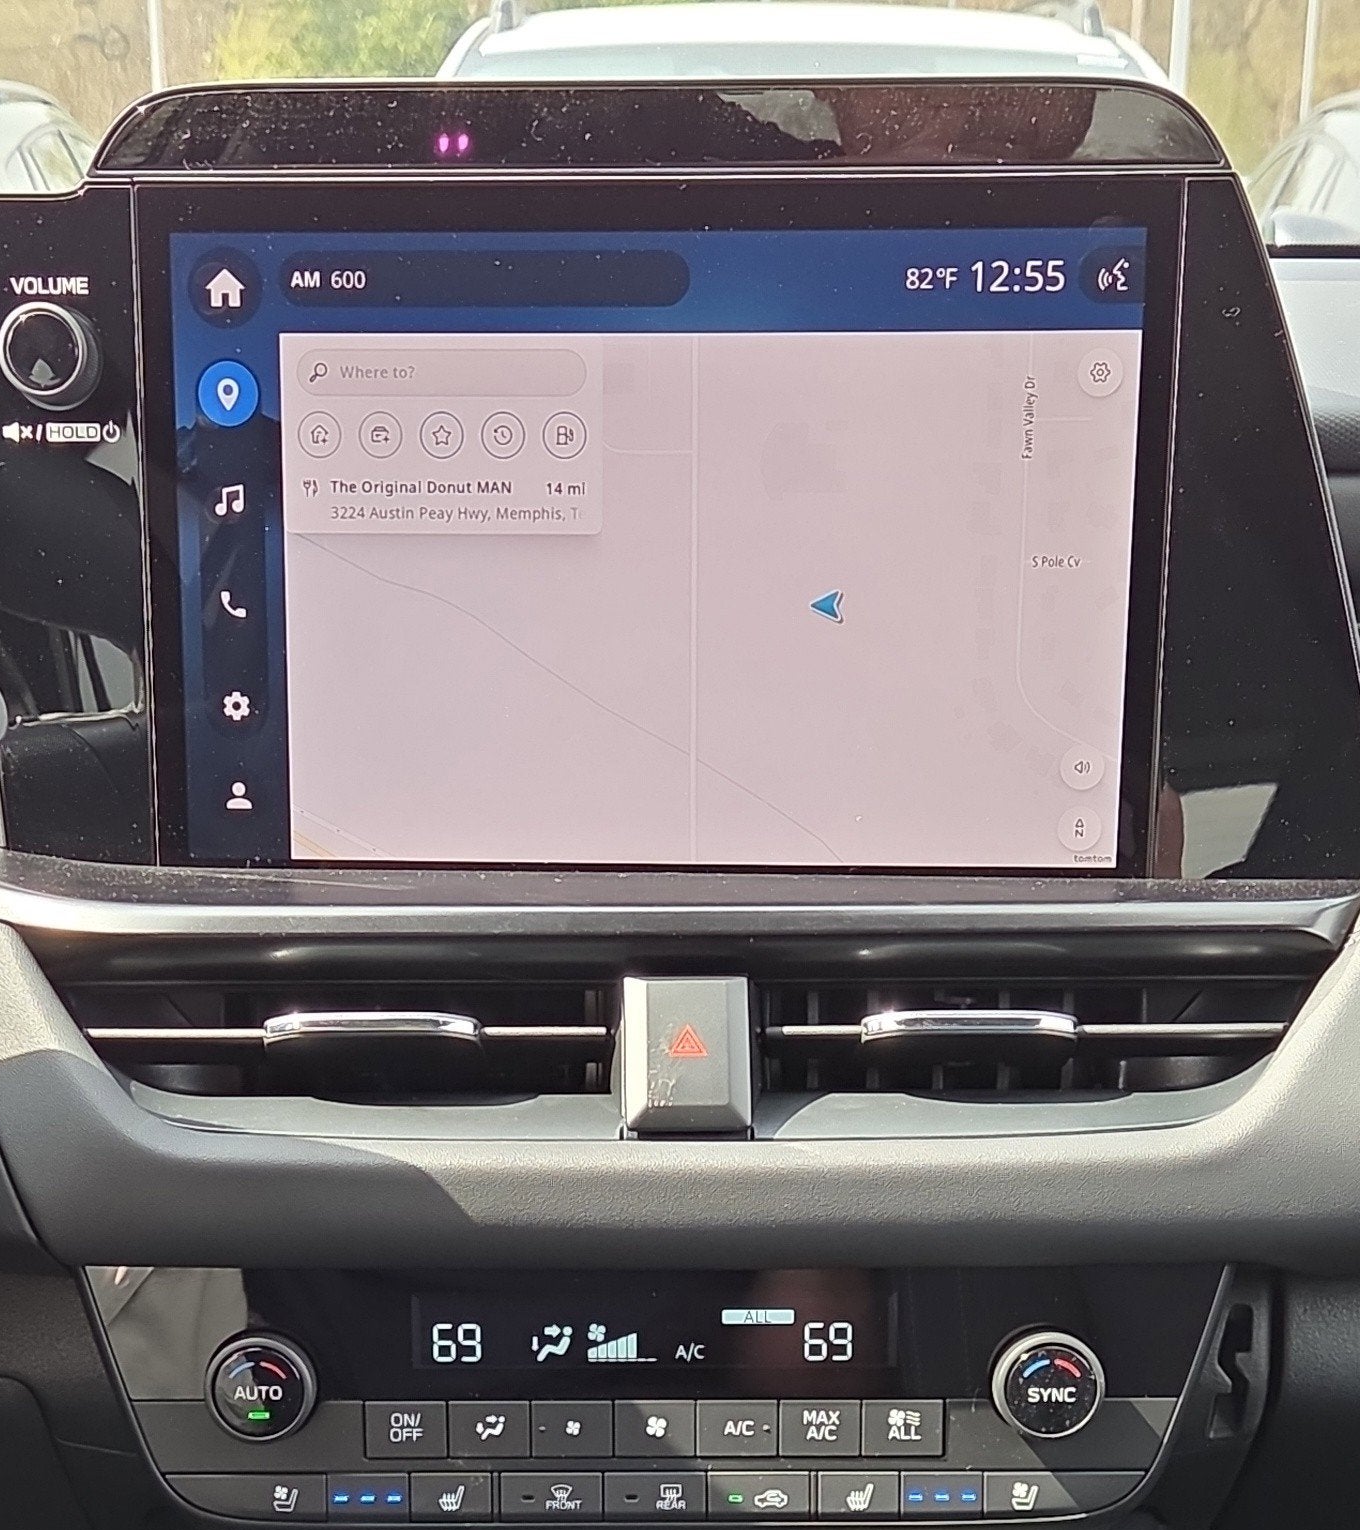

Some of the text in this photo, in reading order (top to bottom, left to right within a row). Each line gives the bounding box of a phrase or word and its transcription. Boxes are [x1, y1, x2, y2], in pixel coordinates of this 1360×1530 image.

[290, 270, 367, 290] AM 600
[971, 260, 1066, 292] 12:55
[9, 276, 90, 295] VOLUME
[339, 364, 415, 380] Where to?
[1021, 375, 1039, 460] Fawn Valley Dr
[49, 426, 98, 439] HOLD
[330, 480, 586, 498] The Original Donut MAN 14 mi
[331, 506, 365, 520] 3224
[369, 505, 414, 520] Austin
[419, 506, 452, 524] Peay
[457, 506, 491, 523] Hwy,
[495, 505, 567, 523] Memphis,
[1031, 554, 1081, 568] S Pole Cv
[1073, 854, 1112, 863] tomtom
[743, 1310, 772, 1323] ALL
[432, 1323, 482, 1362] 69
[803, 1322, 853, 1362] 69
[674, 1343, 705, 1361] A/C
[234, 1385, 283, 1401] AUTO
[1027, 1387, 1076, 1404] SYNC
[390, 1412, 422, 1428] ON/
[803, 1410, 840, 1426] MAX
[389, 1427, 424, 1443] OFF
[724, 1421, 755, 1436] A/C
[806, 1425, 838, 1442] A/C
[888, 1426, 921, 1442] ALL
[545, 1500, 582, 1511] FRONT
[655, 1499, 686, 1511] REAR
